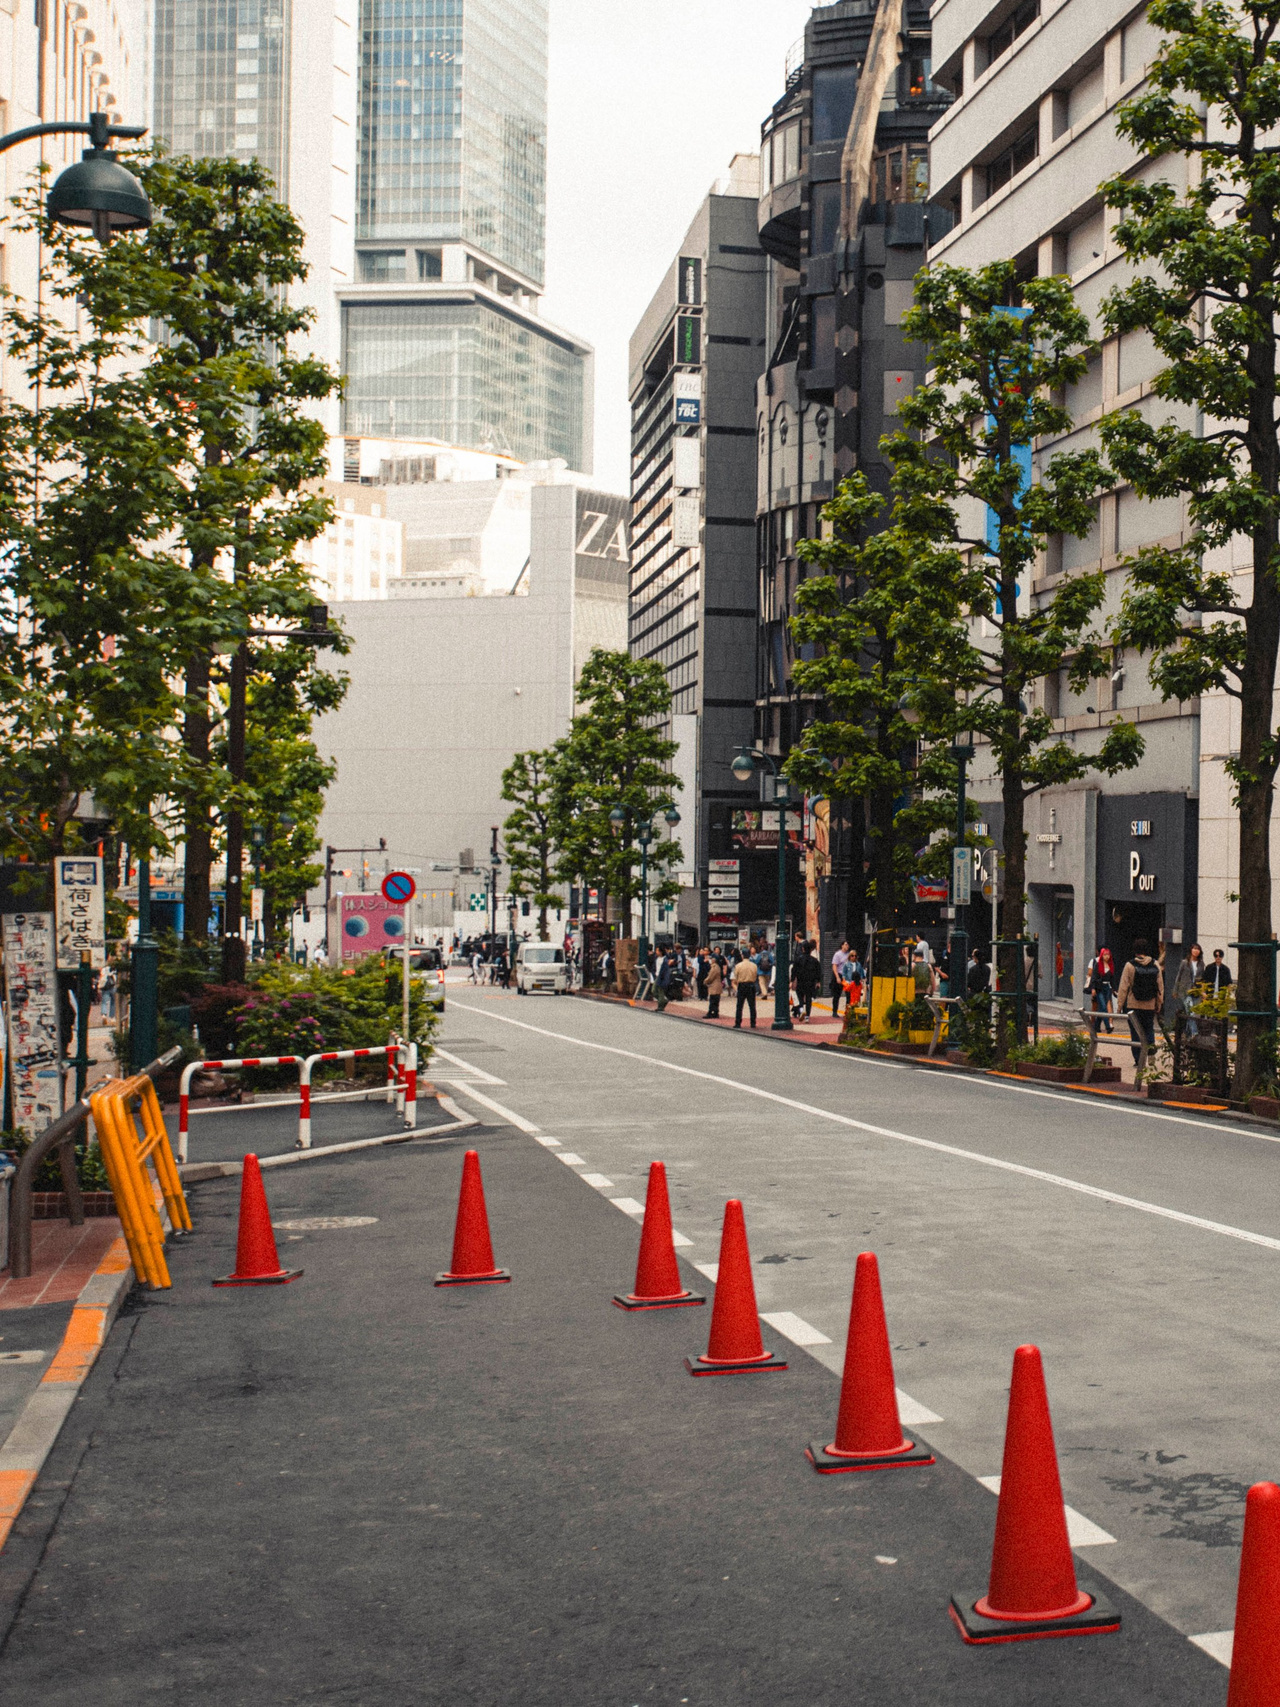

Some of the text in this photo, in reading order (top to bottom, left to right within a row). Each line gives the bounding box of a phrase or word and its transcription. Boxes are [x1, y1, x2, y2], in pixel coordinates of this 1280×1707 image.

[678, 407, 699, 418] TBC
[1131, 821, 1151, 835] SEIBU
[68, 888, 92, 949] 荷さばき
